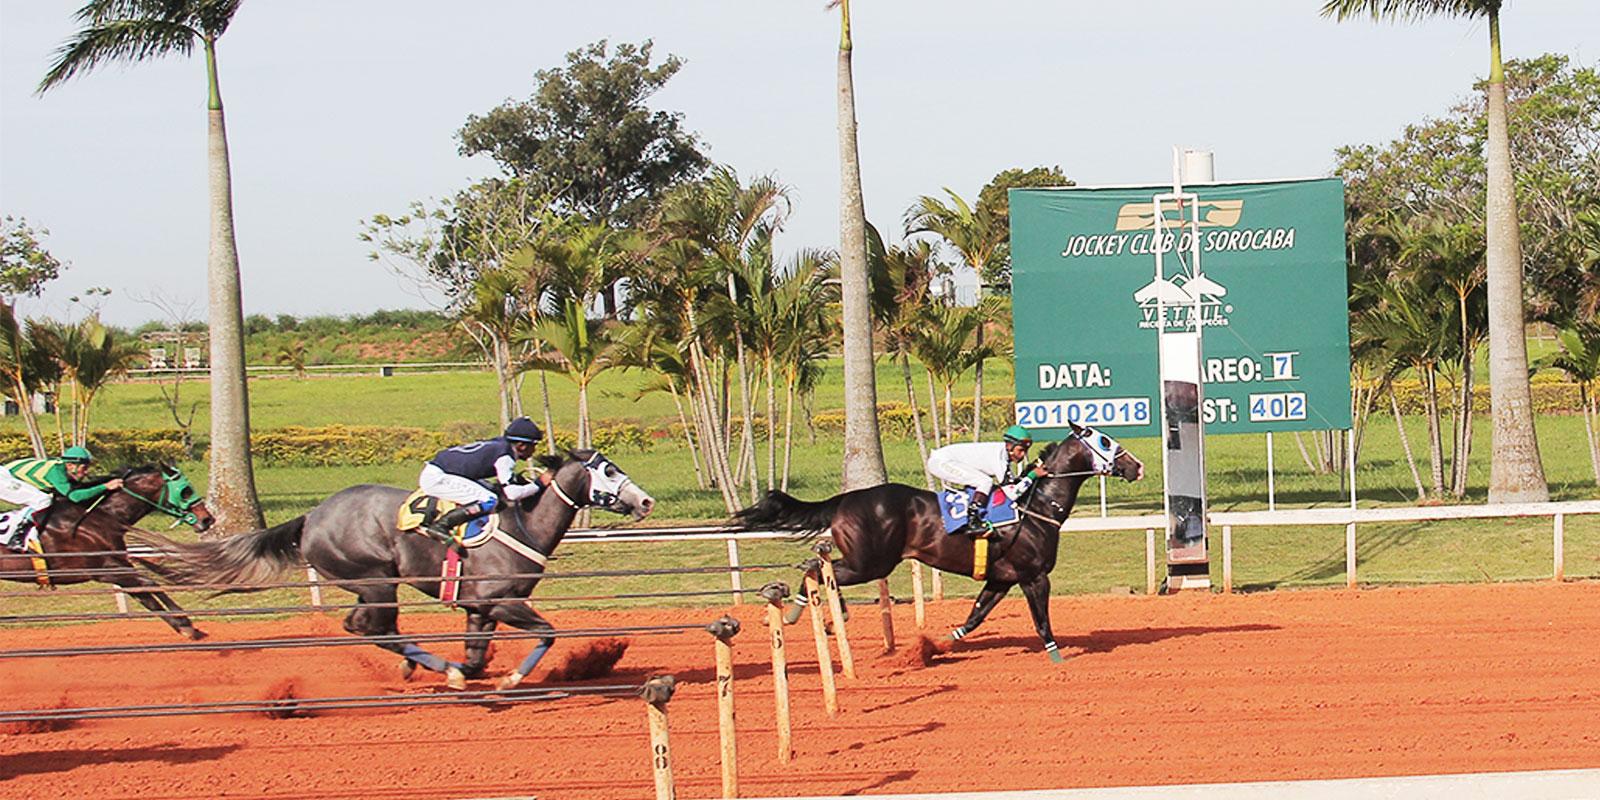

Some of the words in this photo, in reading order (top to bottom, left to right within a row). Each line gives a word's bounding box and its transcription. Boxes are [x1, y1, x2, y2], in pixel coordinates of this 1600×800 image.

[1061, 233, 1129, 257] JOCKEY
[1130, 232, 1175, 255] CLUB
[1203, 228, 1295, 252] SOROCABA
[1039, 363, 1112, 389] DATA:
[1275, 356, 1289, 376] 7
[1017, 401, 1148, 426] 20102018
[408, 494, 438, 527] 4
[810, 589, 821, 607] 5
[718, 674, 731, 698] 7
[654, 743, 668, 770] 8
